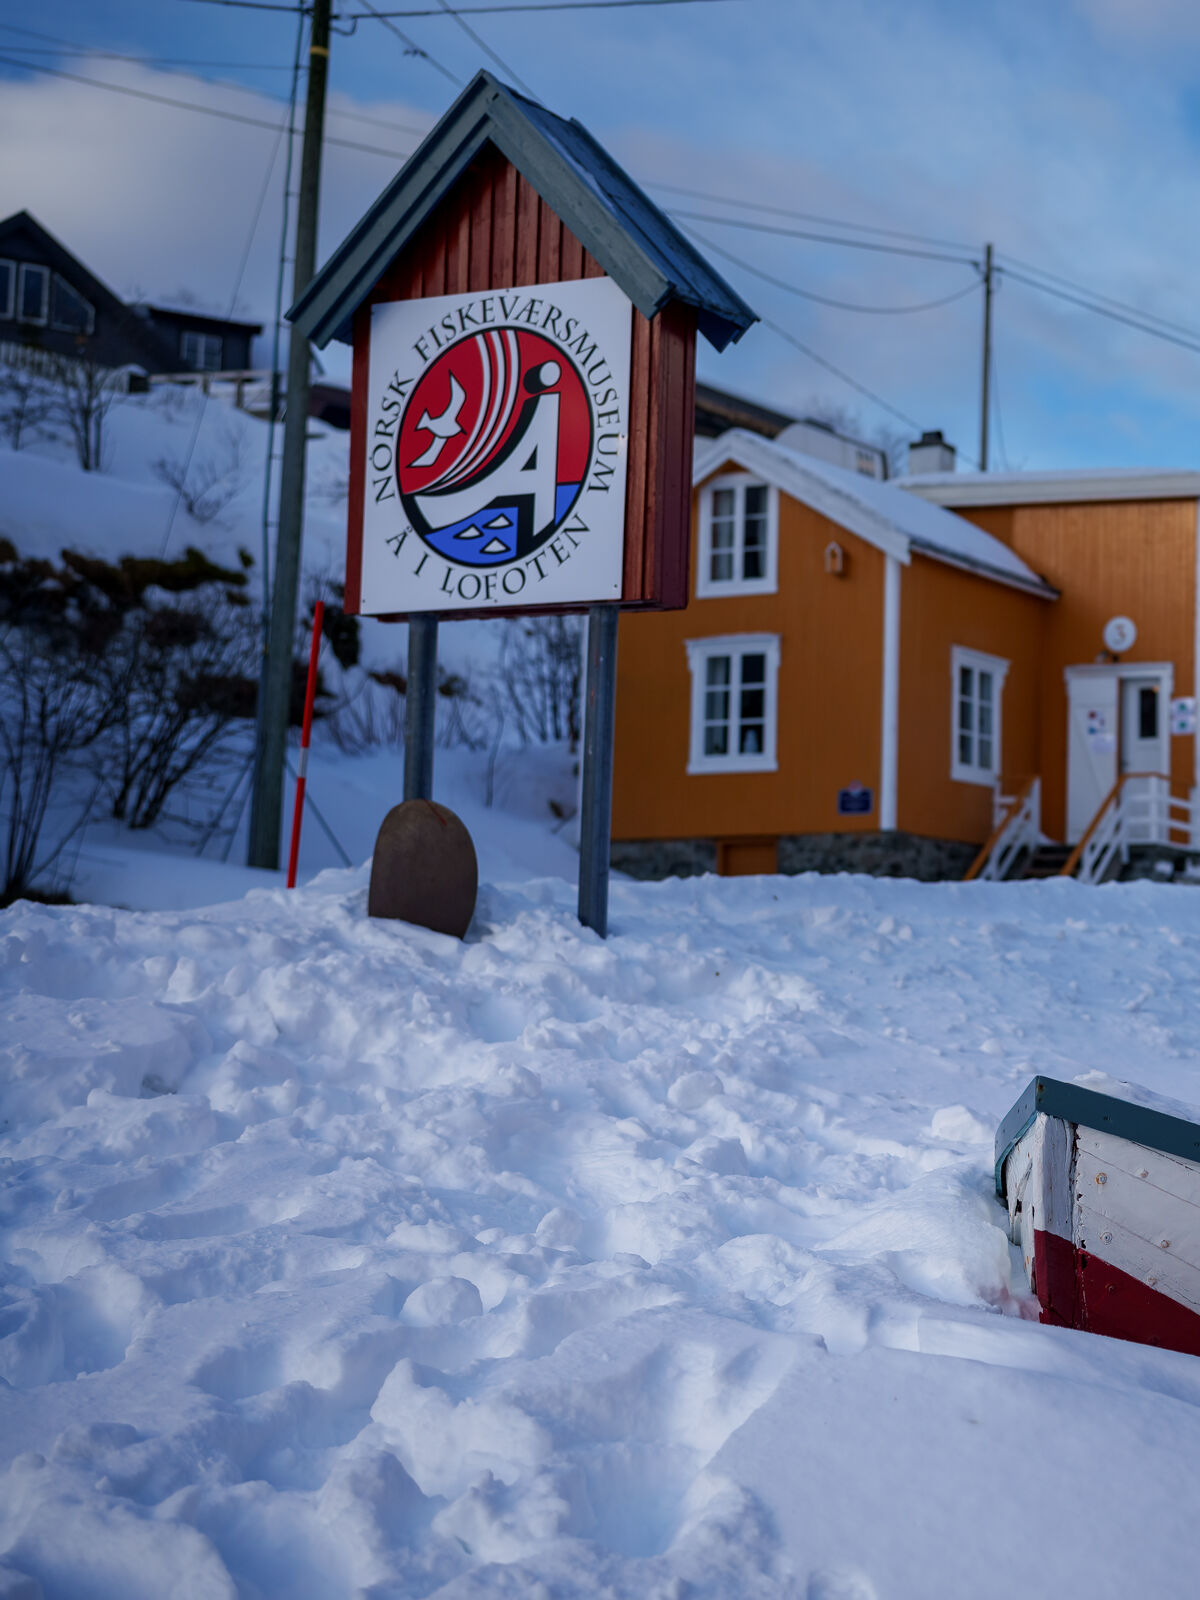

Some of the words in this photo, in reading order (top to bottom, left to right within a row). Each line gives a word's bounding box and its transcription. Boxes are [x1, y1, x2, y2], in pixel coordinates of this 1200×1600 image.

[372, 370, 415, 503] NORSK
[411, 295, 622, 494] FISKEVÆRSMUSEUM
[385, 525, 414, 558] Å
[412, 552, 431, 578] I
[439, 512, 591, 600] LOFOTEN
